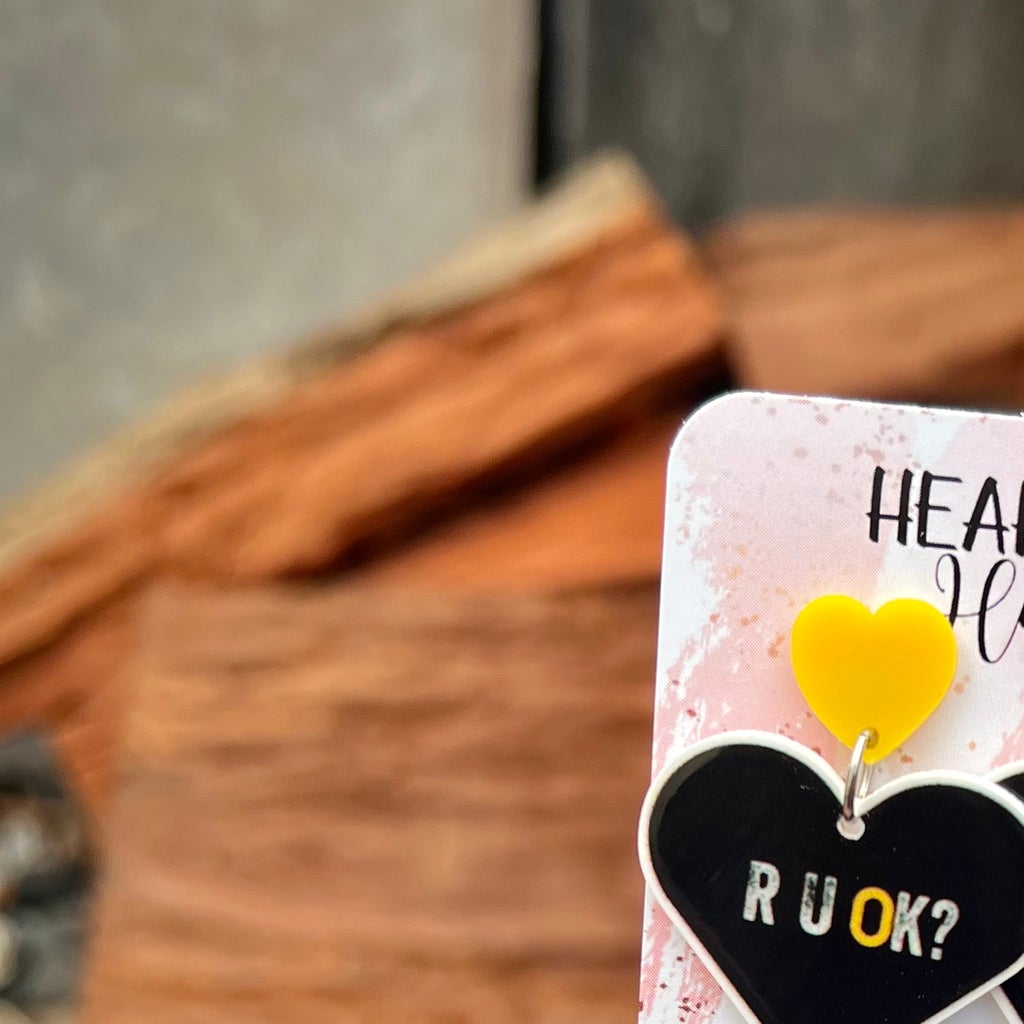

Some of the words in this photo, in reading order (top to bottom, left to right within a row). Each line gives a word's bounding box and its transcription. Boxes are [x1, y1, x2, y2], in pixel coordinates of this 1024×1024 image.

[742, 860, 781, 926] R
[799, 872, 838, 937] U
[849, 886, 961, 961] OK?
